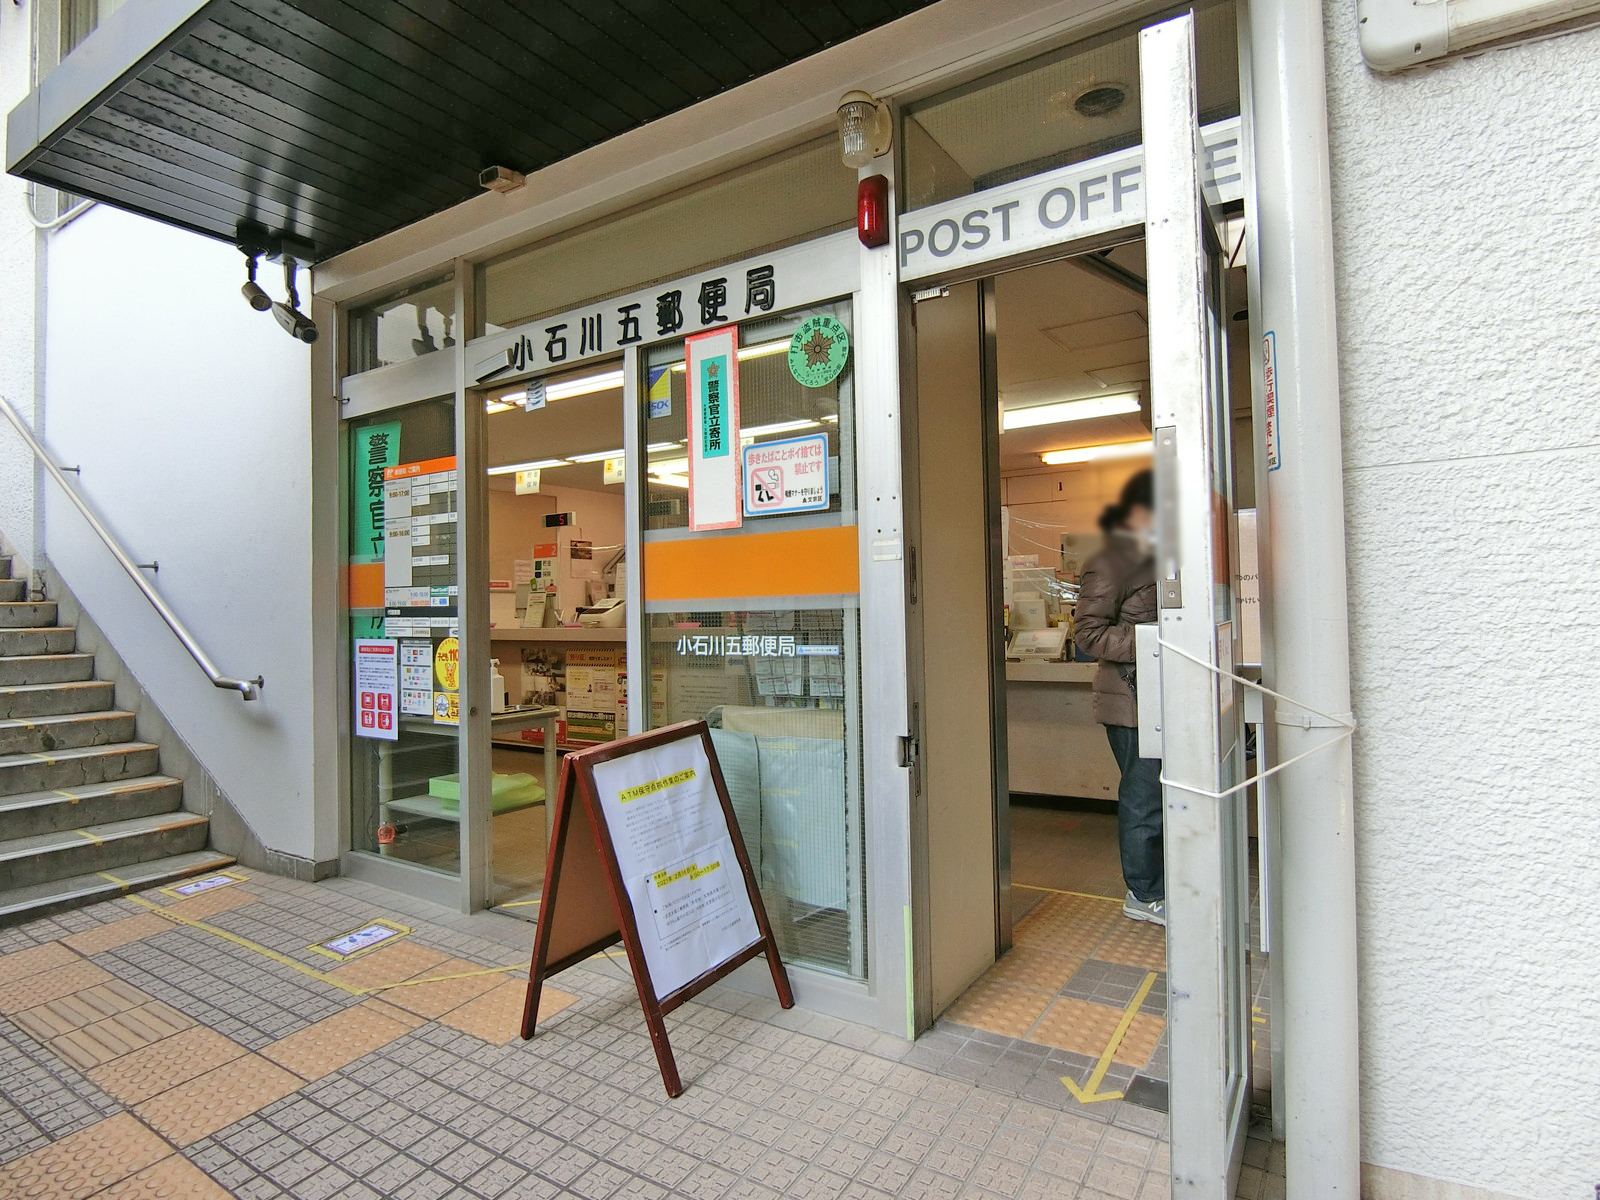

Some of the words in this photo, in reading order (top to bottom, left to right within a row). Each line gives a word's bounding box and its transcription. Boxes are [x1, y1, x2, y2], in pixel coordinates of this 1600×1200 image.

[900, 201, 1020, 268] POST
[1037, 138, 1241, 230] OFFE
[512, 264, 776, 372] 小石川五郵便局
[707, 380, 721, 450] 警察官立寄所
[747, 443, 823, 467] 歩きたばことポイ捨ては
[607, 462, 613, 471] 2
[794, 459, 823, 476] 禁止です
[388, 490, 410, 499] 9:00-17:00
[558, 514, 565, 526] 5
[389, 529, 410, 538] 9:00-16:00
[551, 545, 557, 556] 2
[676, 635, 796, 657] 小石川五郵便局
[620, 769, 697, 801] ATM保守点検作業のご案内
